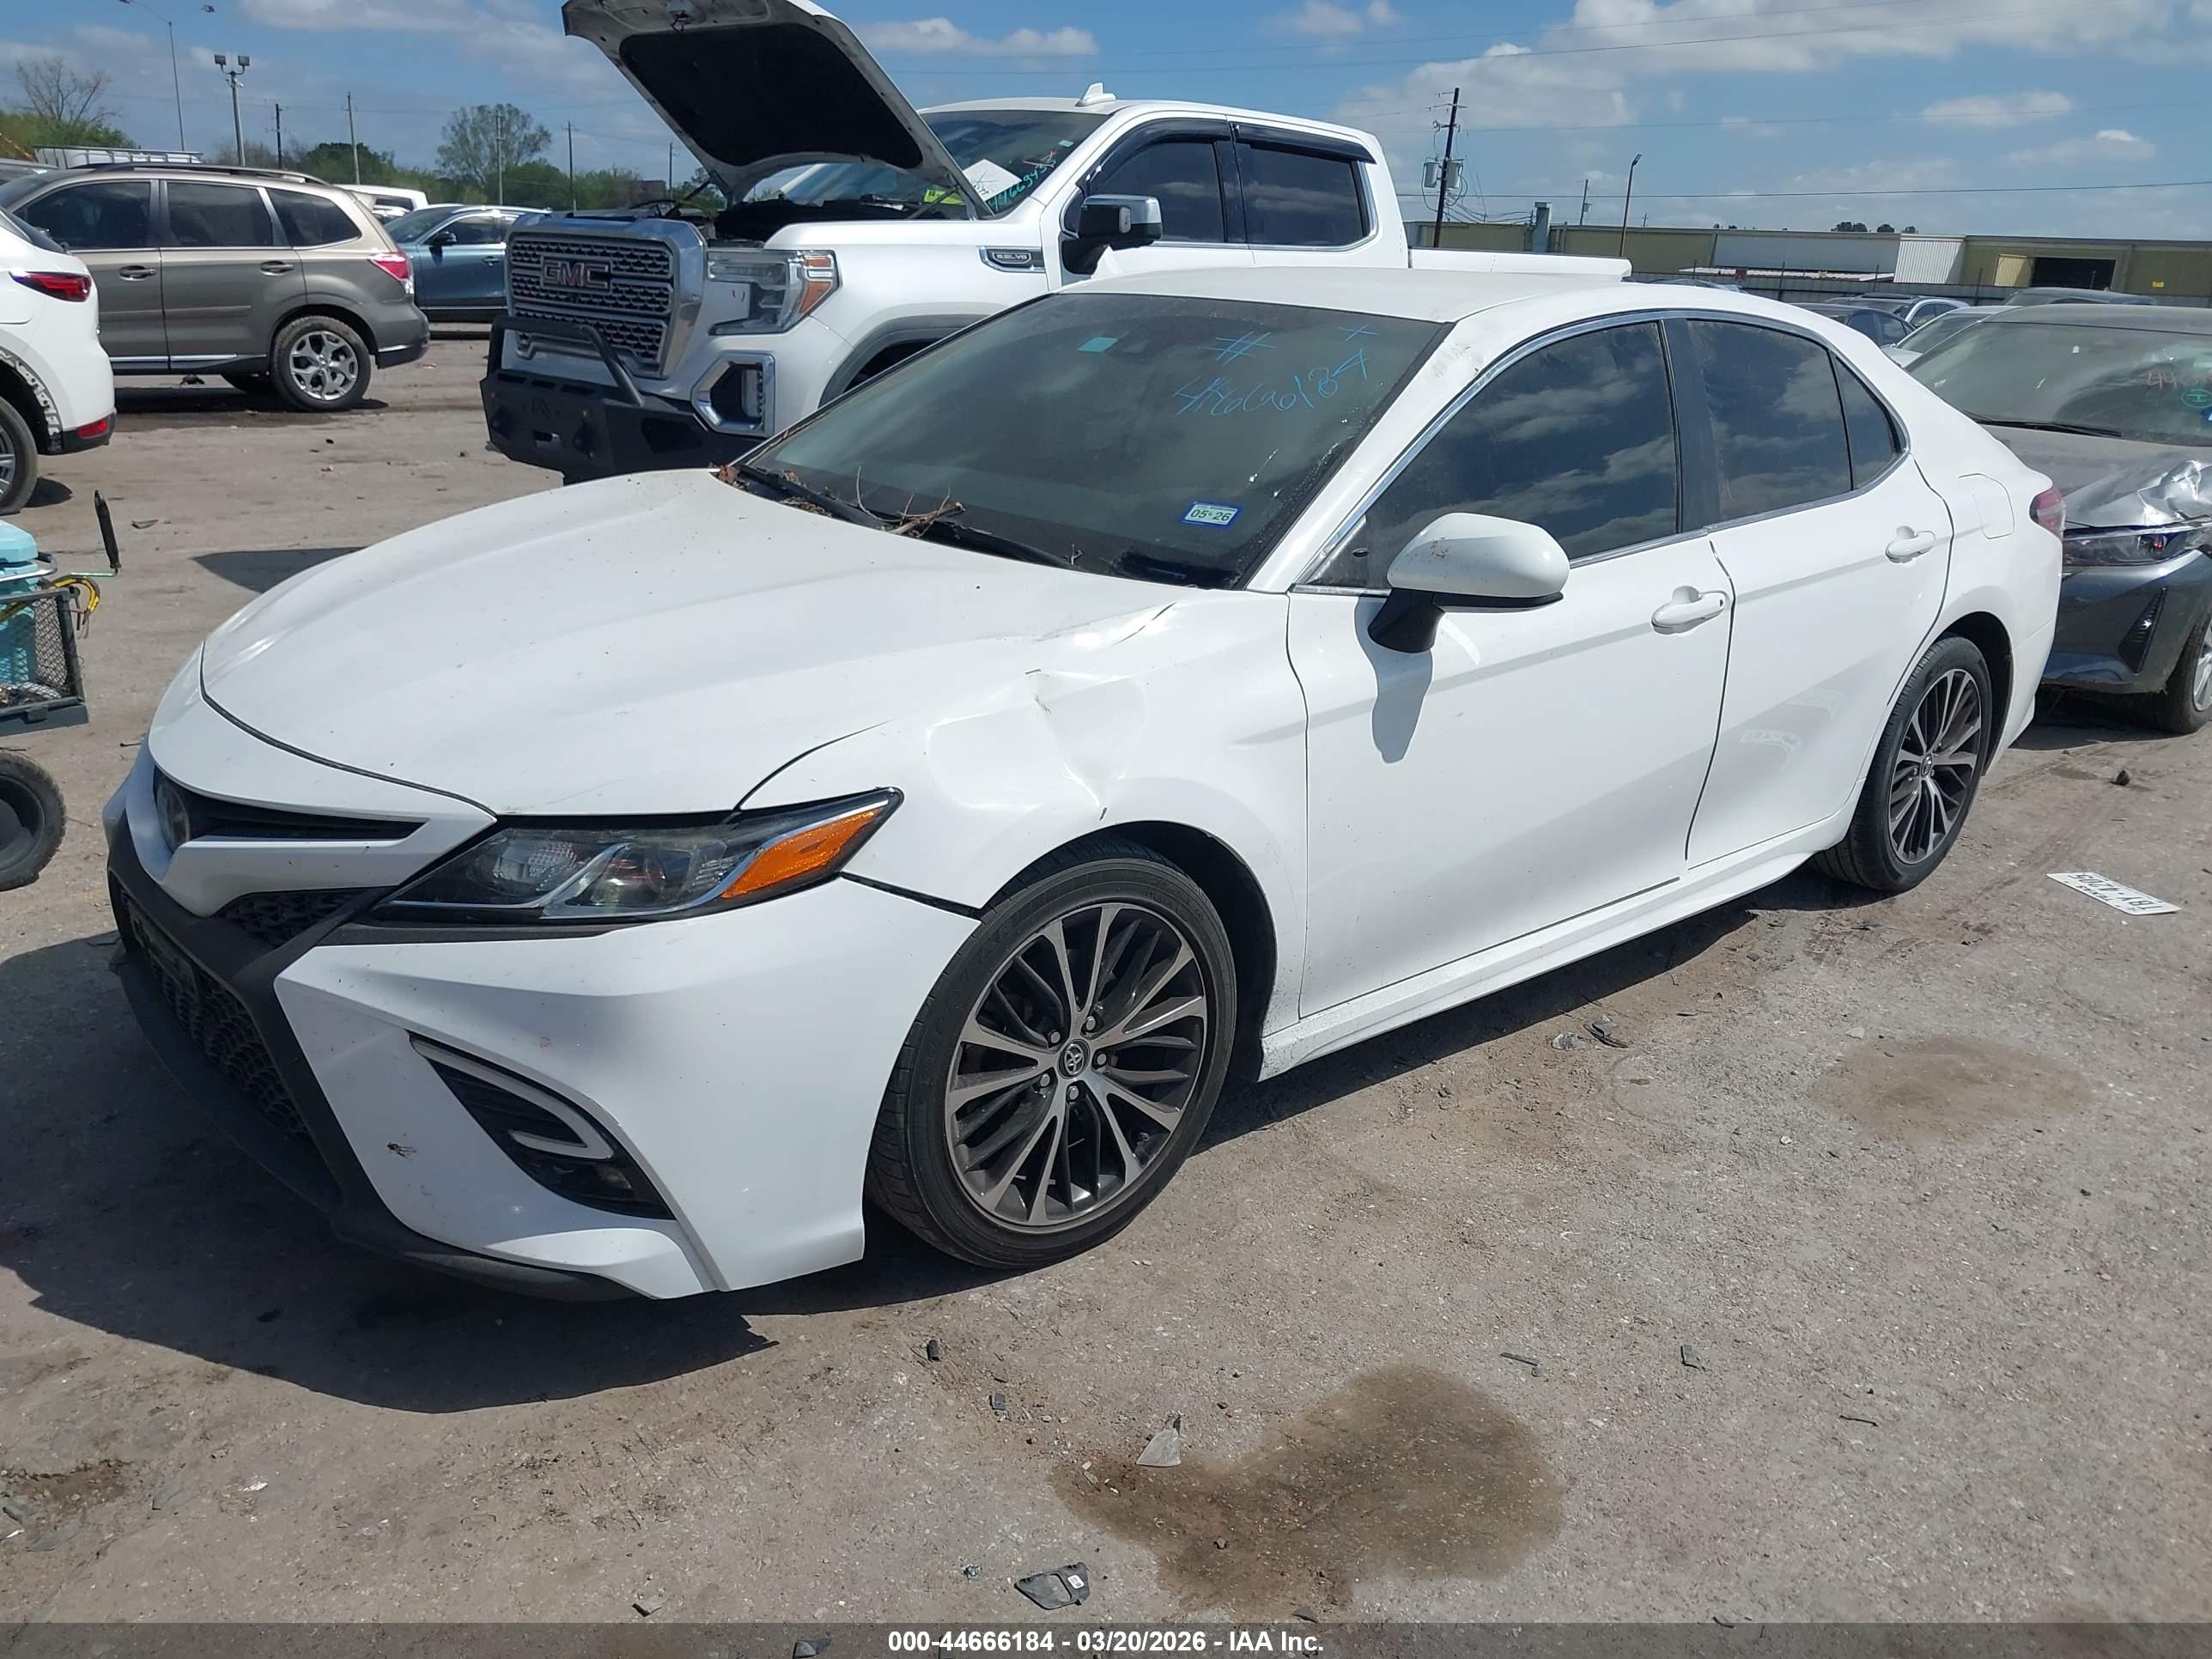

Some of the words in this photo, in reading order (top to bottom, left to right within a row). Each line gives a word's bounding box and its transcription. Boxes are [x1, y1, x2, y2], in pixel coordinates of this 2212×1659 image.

[544, 260, 609, 289] GMC
[1190, 509, 1209, 519] 05
[1212, 512, 1232, 521] 26
[2075, 884, 2113, 902] TEXAS
